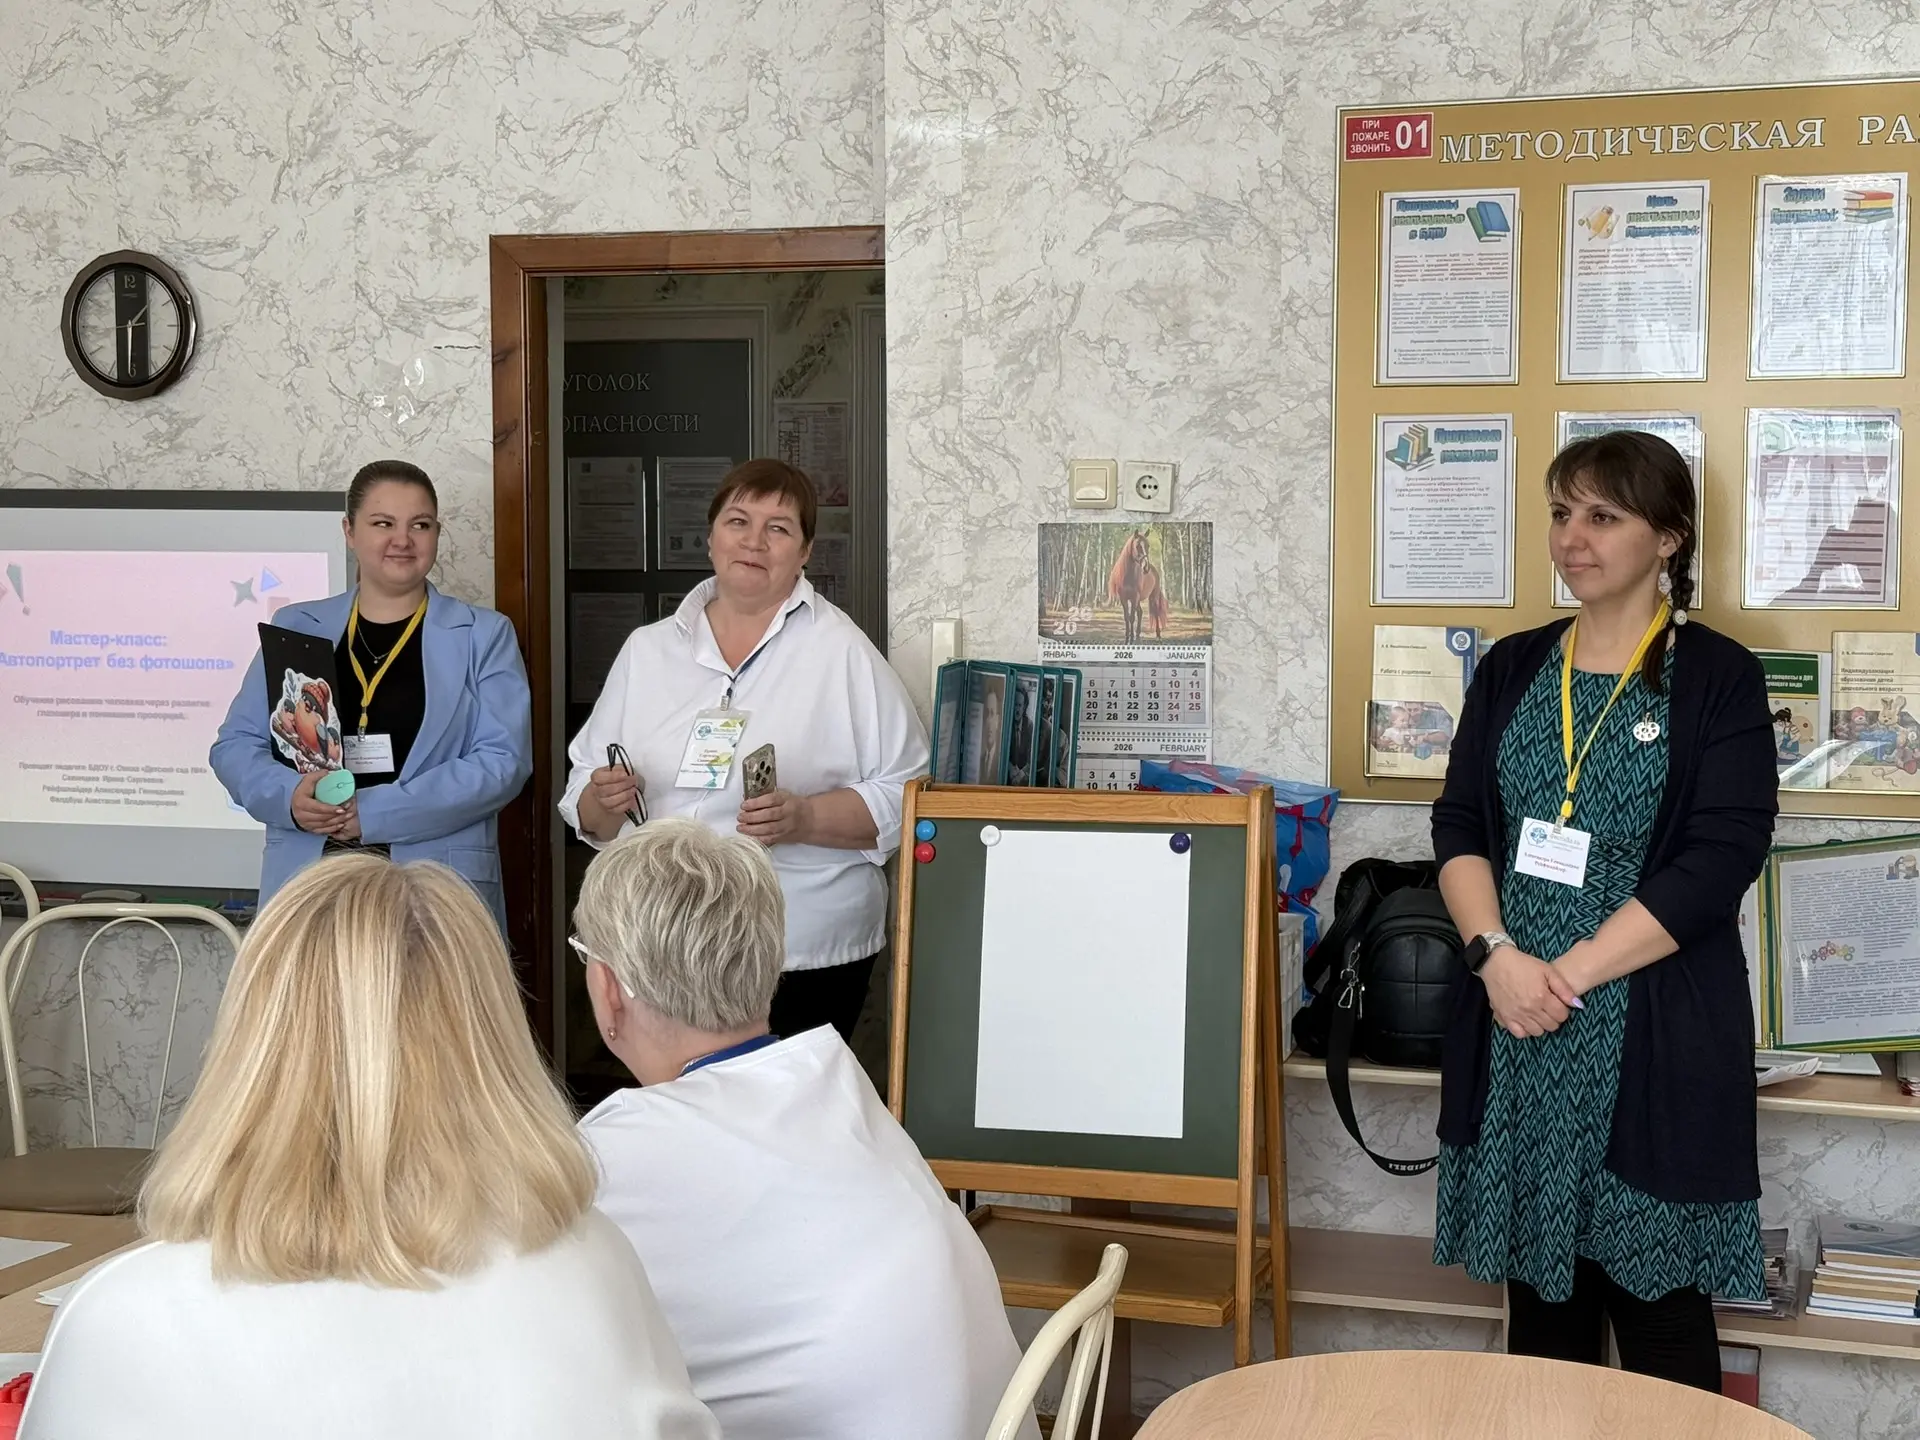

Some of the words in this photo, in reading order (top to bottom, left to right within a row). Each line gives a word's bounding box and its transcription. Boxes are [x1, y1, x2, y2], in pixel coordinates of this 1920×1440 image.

[1362, 119, 1380, 130] ПРИ
[1352, 131, 1390, 142] ПОЖАРЕ
[1395, 119, 1429, 150] 01
[1439, 117, 1826, 163] МЕТОДИЧЕСКАЯ
[1858, 113, 1920, 146] РА
[1350, 143, 1391, 154] ЗВОНИТЬ
[123, 274, 136, 289] 12
[561, 373, 650, 392] УГОЛОК
[1053, 621, 1077, 635] 20
[50, 630, 168, 649] Мастер-класс:
[1043, 651, 1077, 660] ЯНВАРЬ
[1114, 651, 1133, 659] 2026
[1166, 652, 1207, 660] JANUARY
[0, 653, 100, 670] Автопортрет
[107, 653, 135, 668] без
[139, 655, 234, 671] фотошопа»
[1151, 669, 1156, 677] 2
[1171, 669, 1177, 677] 3
[1130, 680, 1136, 688] 8
[1150, 680, 1156, 688] 9
[1087, 690, 1098, 698] 13
[1148, 691, 1159, 699] 16
[1148, 702, 1159, 710] 23
[1168, 702, 1179, 710] 24
[1086, 712, 1097, 720] 27
[1148, 713, 1159, 721] 30
[1114, 743, 1133, 752] 2026
[1160, 744, 1207, 753] FEBRUARY
[1089, 771, 1095, 779] 3
[1087, 782, 1098, 790] 10
